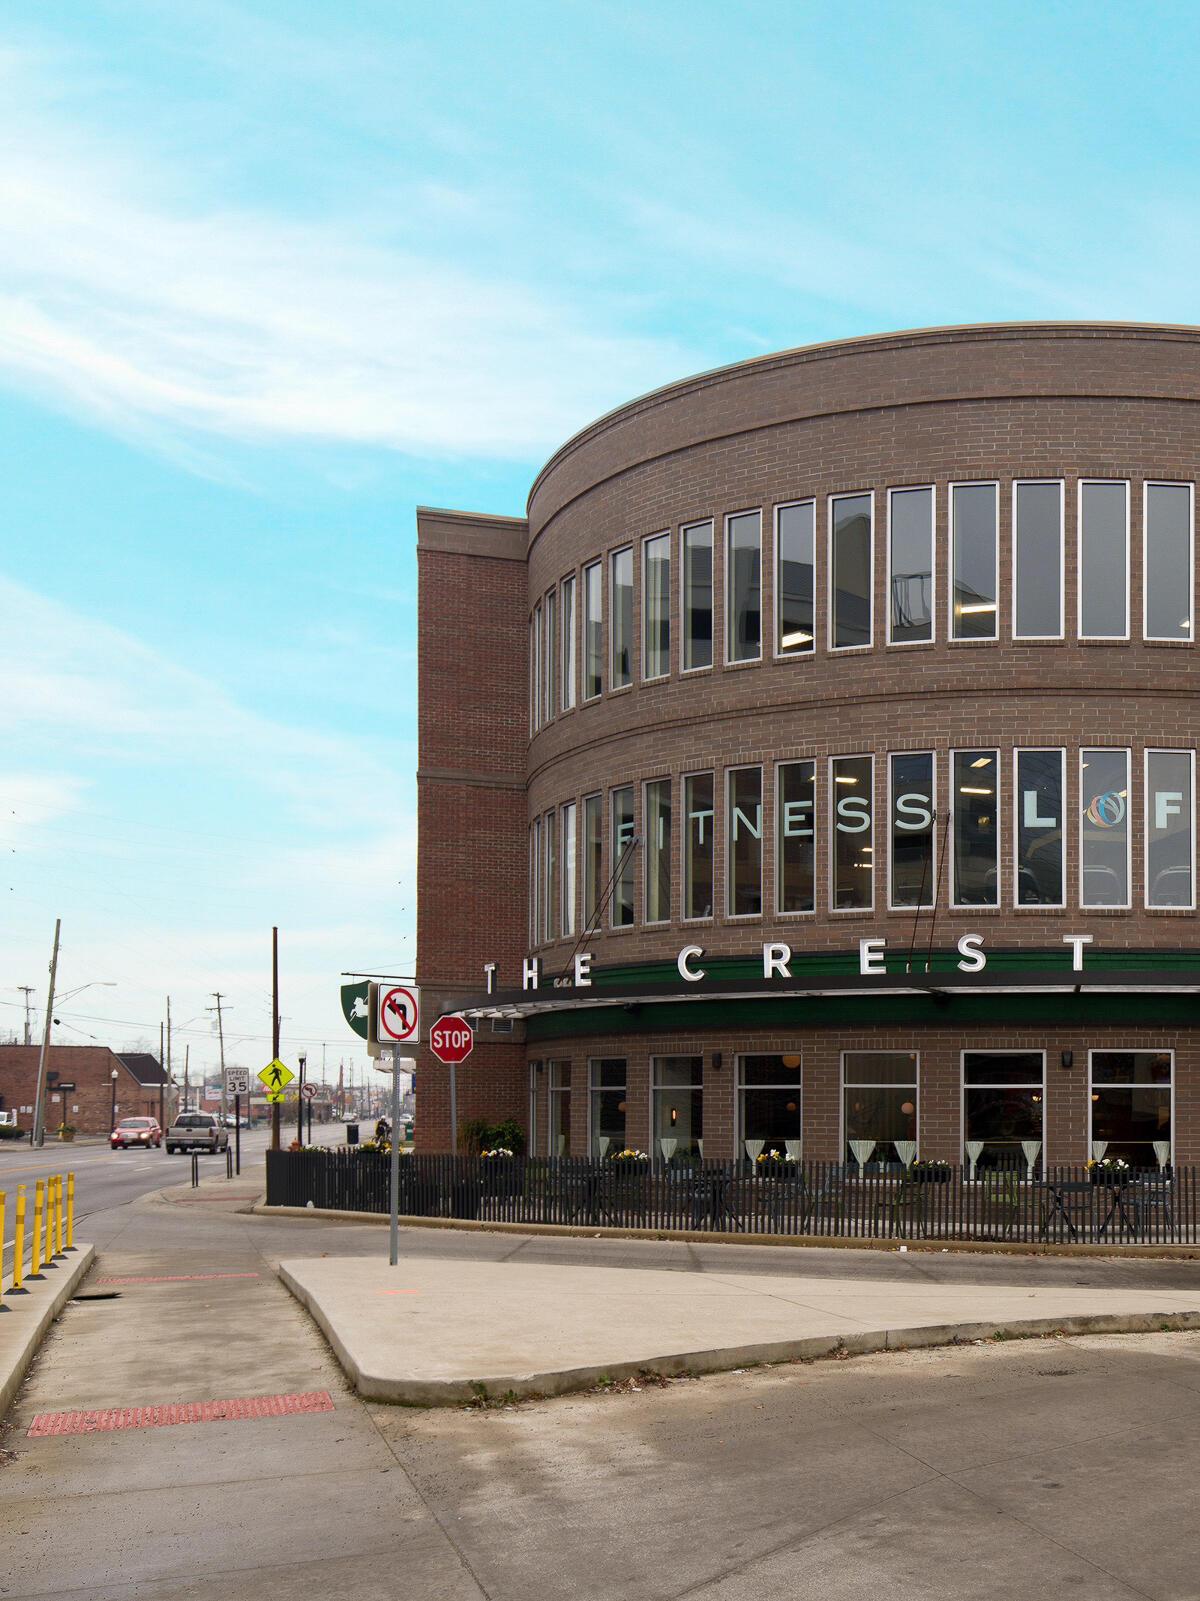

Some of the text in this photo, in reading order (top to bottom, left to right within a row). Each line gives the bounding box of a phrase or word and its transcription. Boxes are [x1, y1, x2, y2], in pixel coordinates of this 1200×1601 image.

[617, 793, 933, 857] FITNESS
[484, 934, 1094, 995] THE CREST
[433, 1030, 470, 1049] STOP
[228, 1082, 247, 1092] 35
